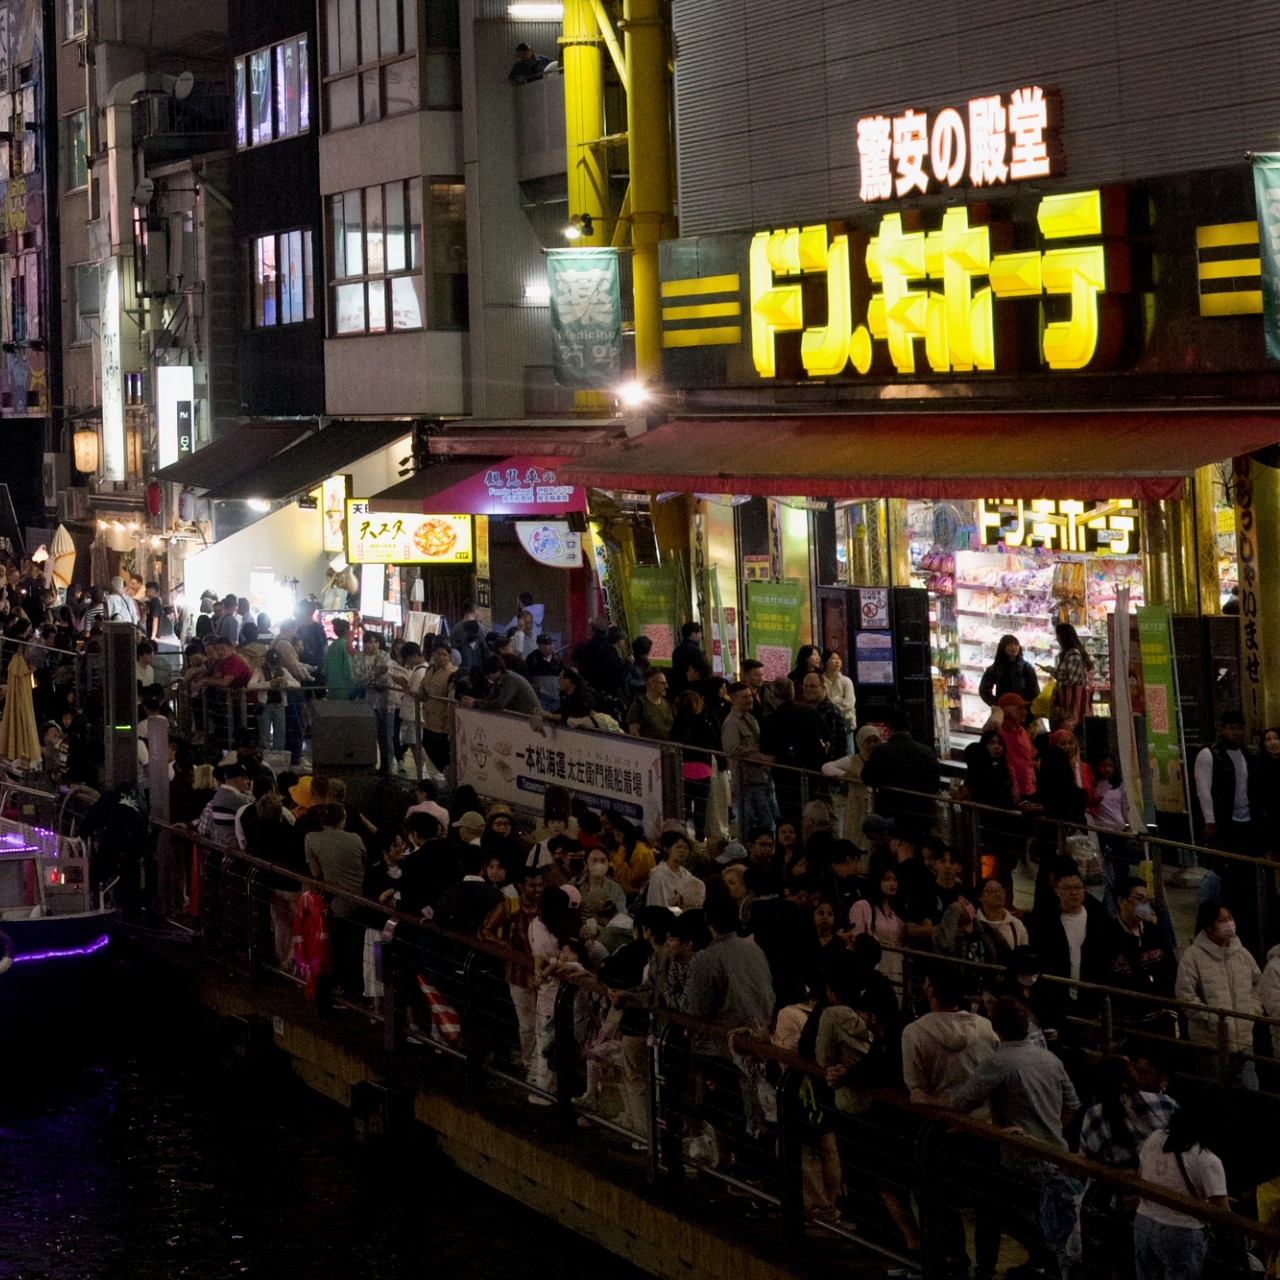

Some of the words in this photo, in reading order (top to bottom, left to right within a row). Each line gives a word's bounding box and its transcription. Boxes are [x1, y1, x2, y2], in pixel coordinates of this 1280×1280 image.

[857, 85, 1049, 203] 驚安の殿堂
[555, 268, 614, 325] 薬
[484, 468, 556, 487] 観覧車の
[515, 744, 566, 780] 一本松海運
